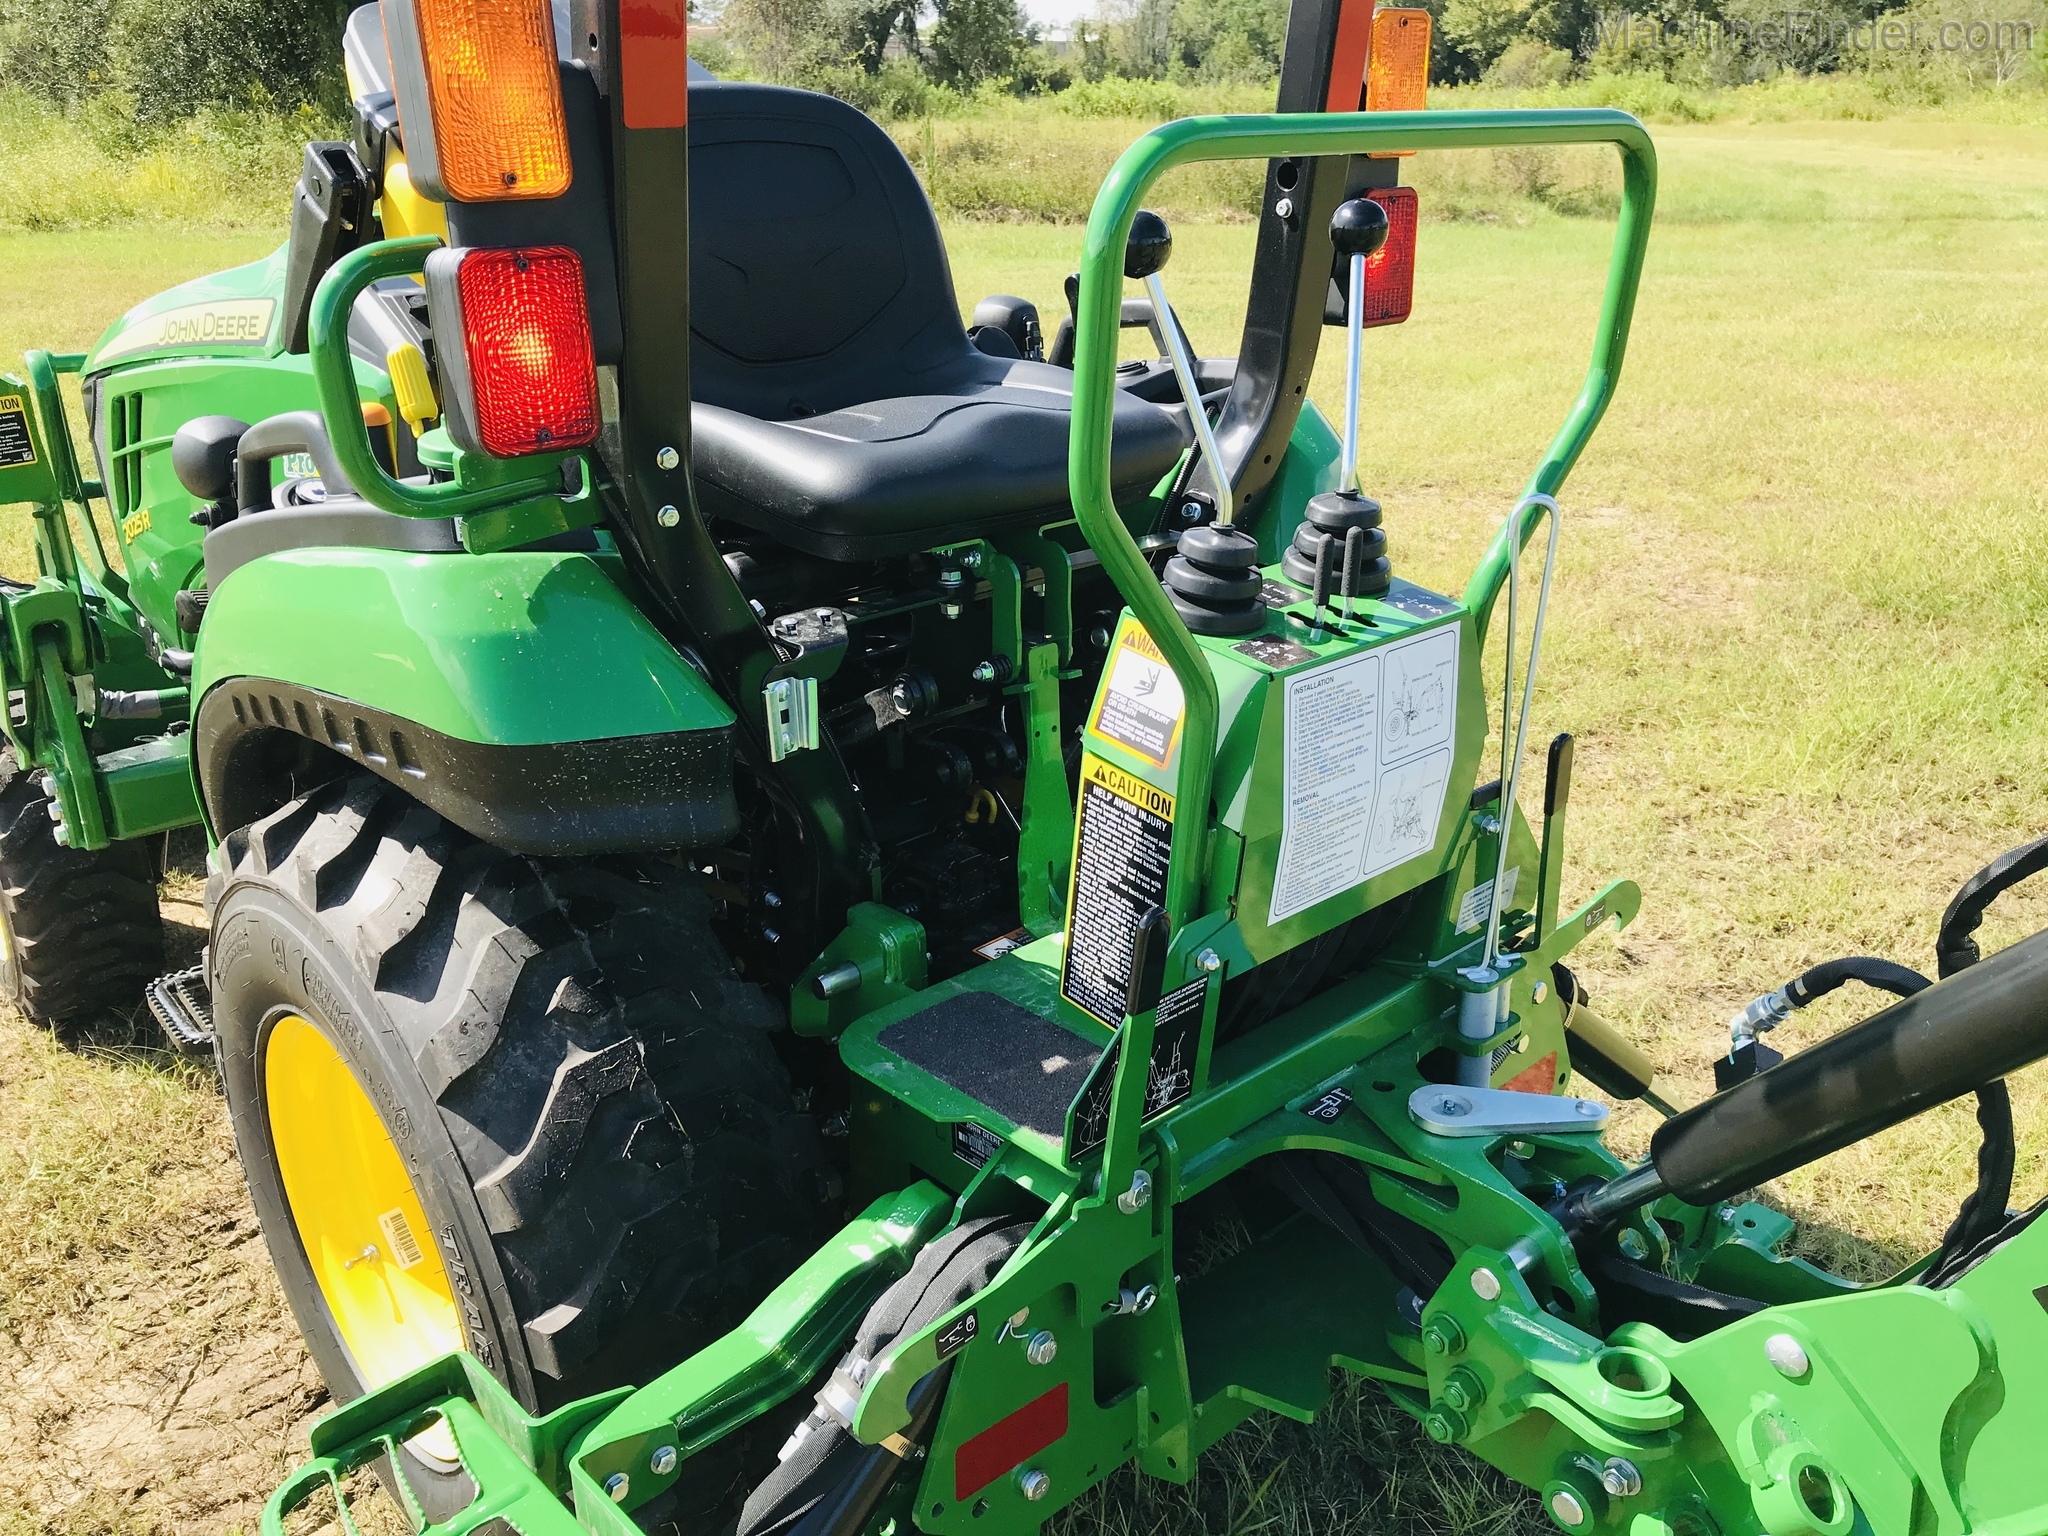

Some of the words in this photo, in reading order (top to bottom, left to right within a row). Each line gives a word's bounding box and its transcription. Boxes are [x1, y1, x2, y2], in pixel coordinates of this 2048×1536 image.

[159, 317, 200, 342] JOHN
[202, 312, 260, 337] DEERE
[1293, 675, 1334, 695] INSTALLATION
[1092, 784, 1112, 803] HELP
[1112, 795, 1137, 816] AVOID
[1137, 808, 1167, 833] INJURY
[1108, 770, 1172, 818] CAUTION
[1292, 789, 1319, 806] REMOVAL
